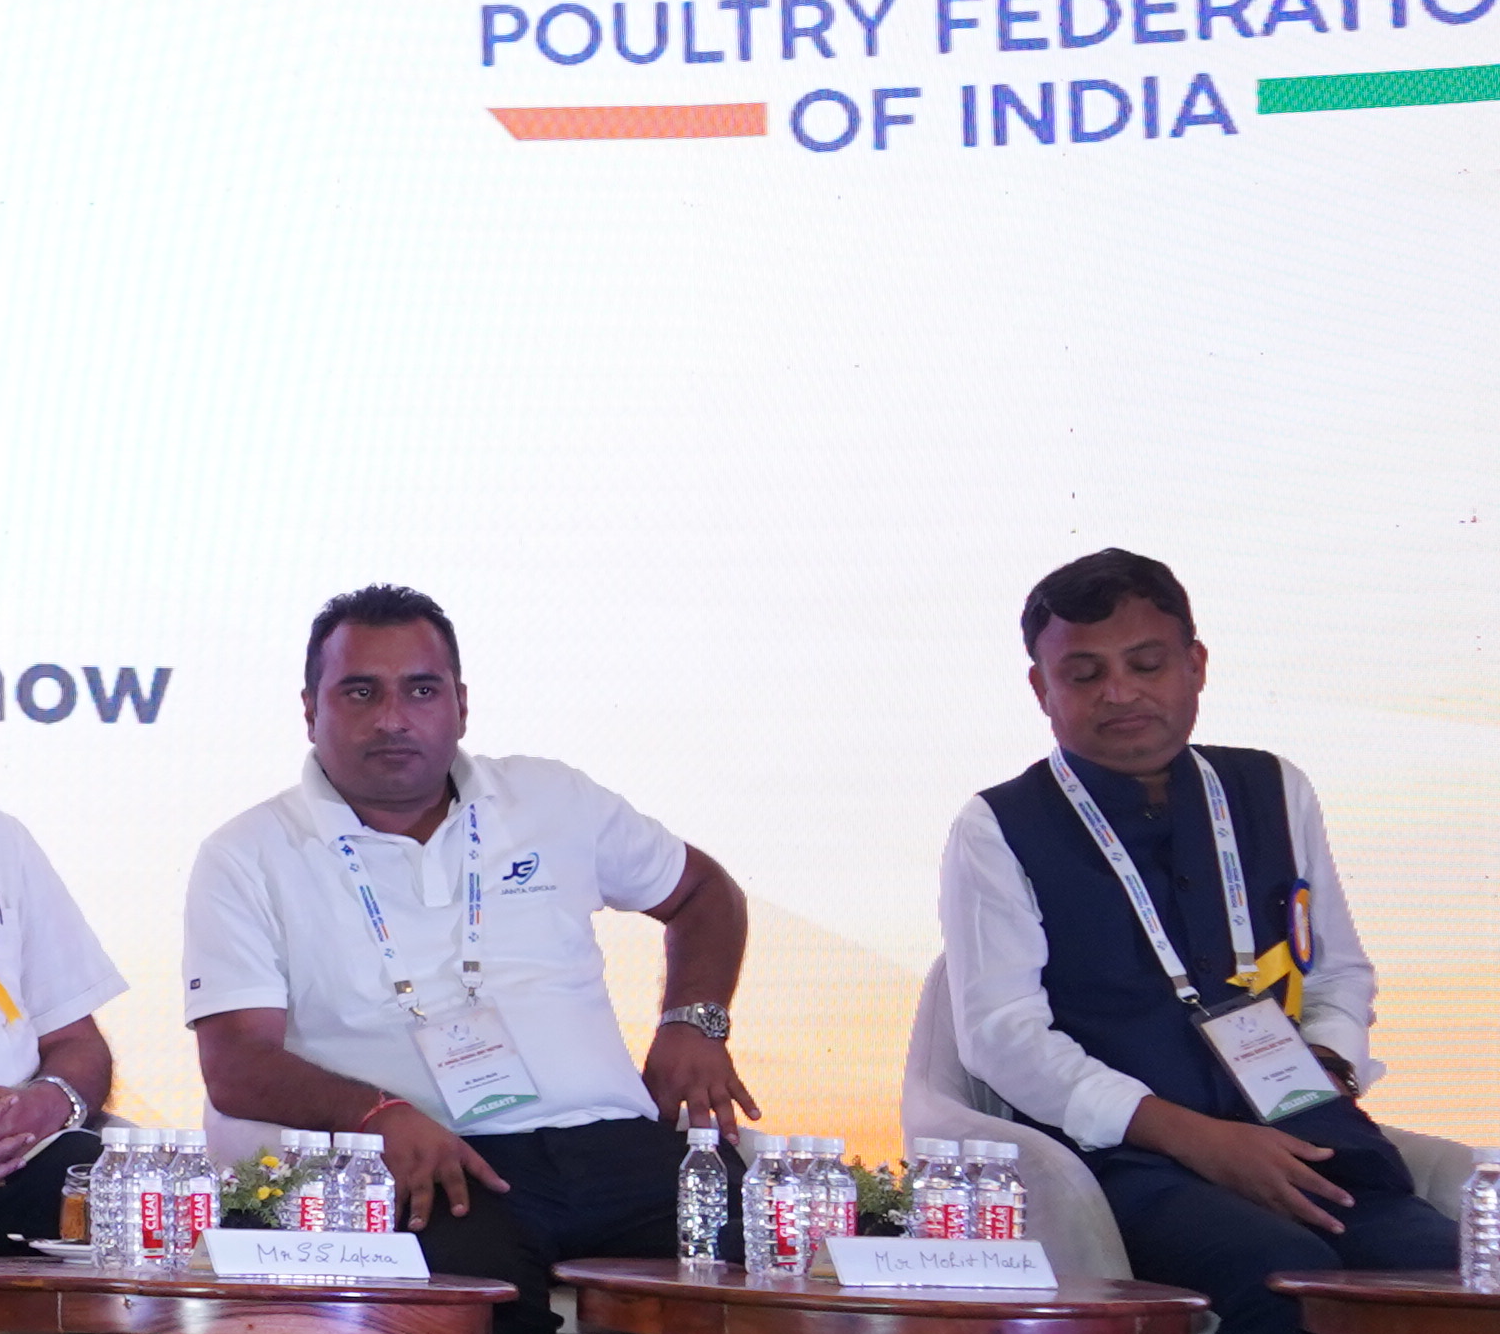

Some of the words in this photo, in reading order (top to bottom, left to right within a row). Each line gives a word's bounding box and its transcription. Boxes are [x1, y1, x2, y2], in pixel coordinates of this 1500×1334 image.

[788, 85, 923, 155] OF
[959, 70, 1239, 150] INDIA
[143, 1193, 158, 1231] CLEAR
[192, 1193, 207, 1230] CLEAR
[919, 1251, 979, 1269] Mohit
